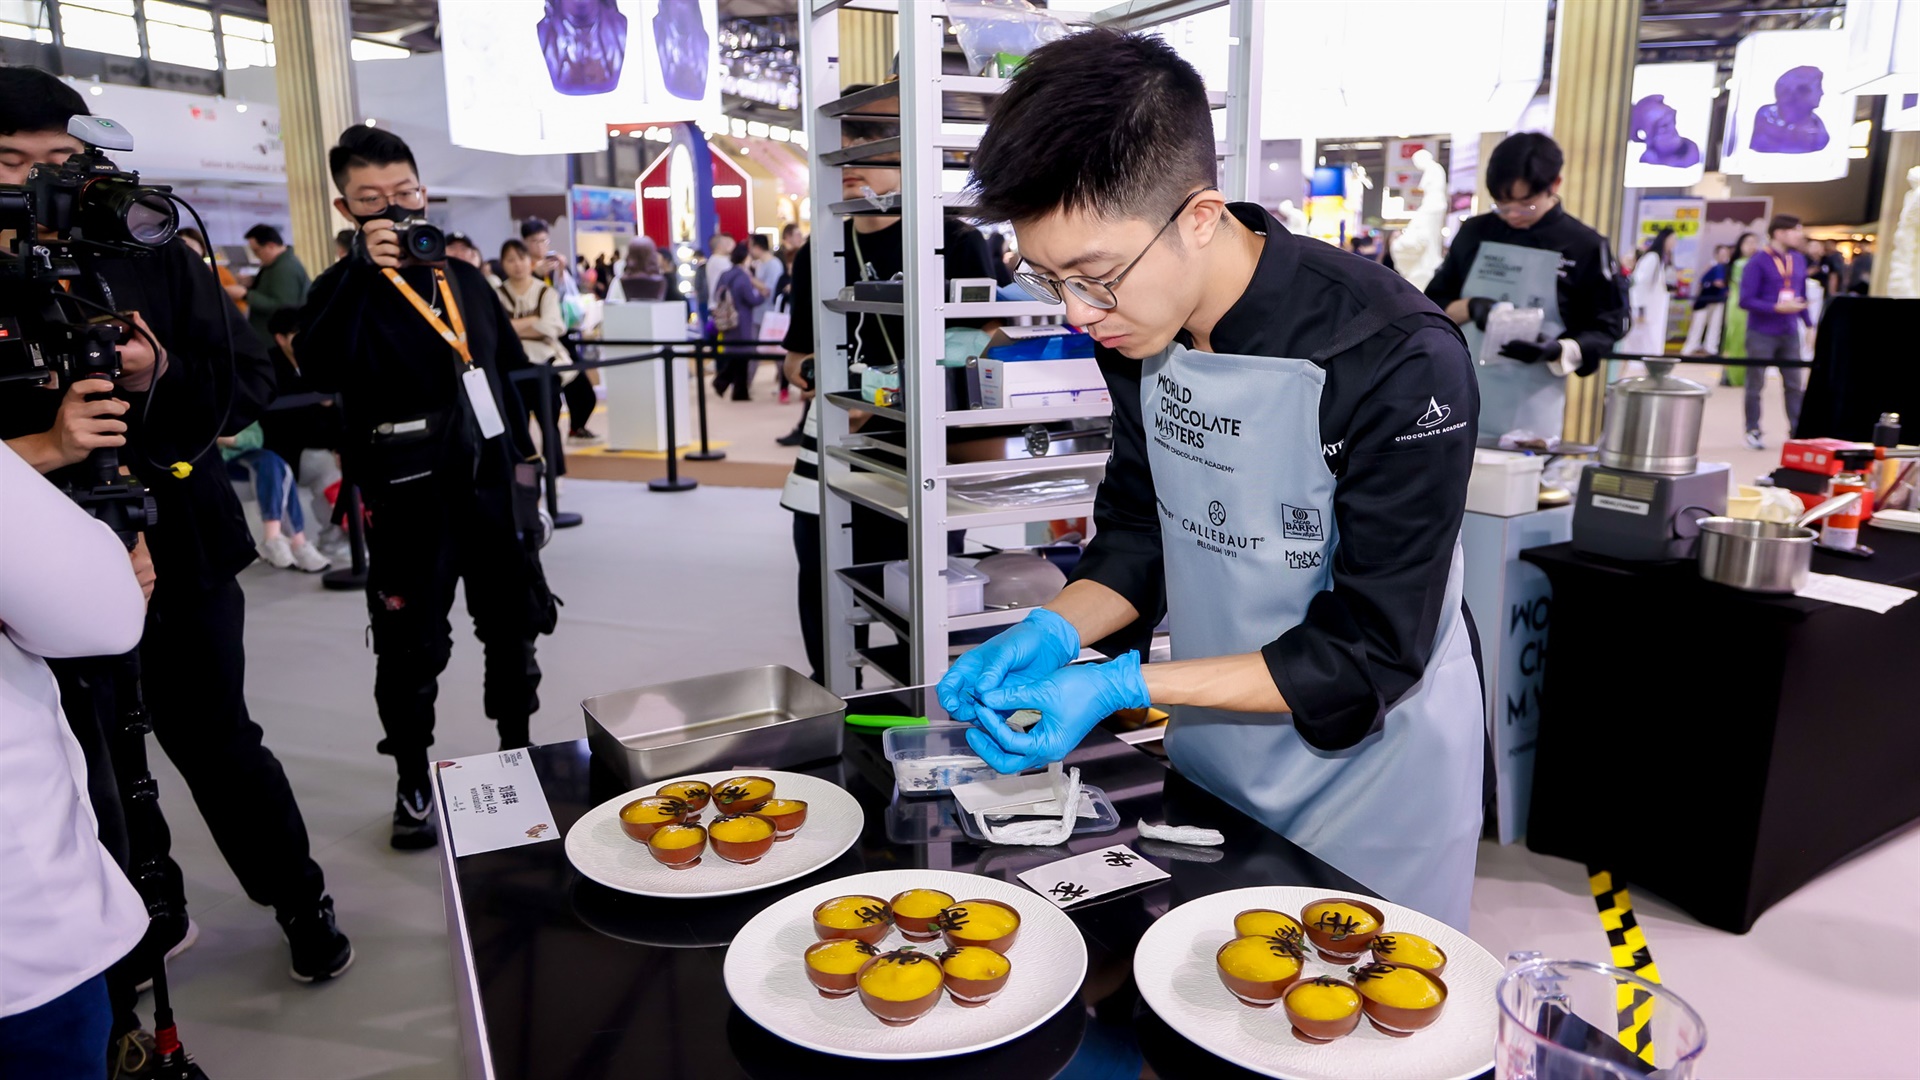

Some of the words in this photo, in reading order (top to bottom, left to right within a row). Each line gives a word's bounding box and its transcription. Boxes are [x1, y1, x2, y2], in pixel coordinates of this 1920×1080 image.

[1156, 373, 1192, 404] WORLD
[1161, 396, 1241, 437] CHOCOLATE
[1155, 412, 1204, 449] MASTERS
[1395, 429, 1440, 442] CHOCOLATE
[1442, 421, 1467, 434] ACADEMY
[1171, 446, 1203, 464] CHOCOLATE
[1204, 460, 1234, 473] ACADEMY
[1285, 522, 1319, 533] BARRY
[1197, 539, 1222, 555] BELGIUM
[1224, 549, 1237, 558] 1911
[1510, 596, 1550, 637] WO
[481, 783, 495, 802] Jeffrey
[486, 802, 498, 814] Lao
